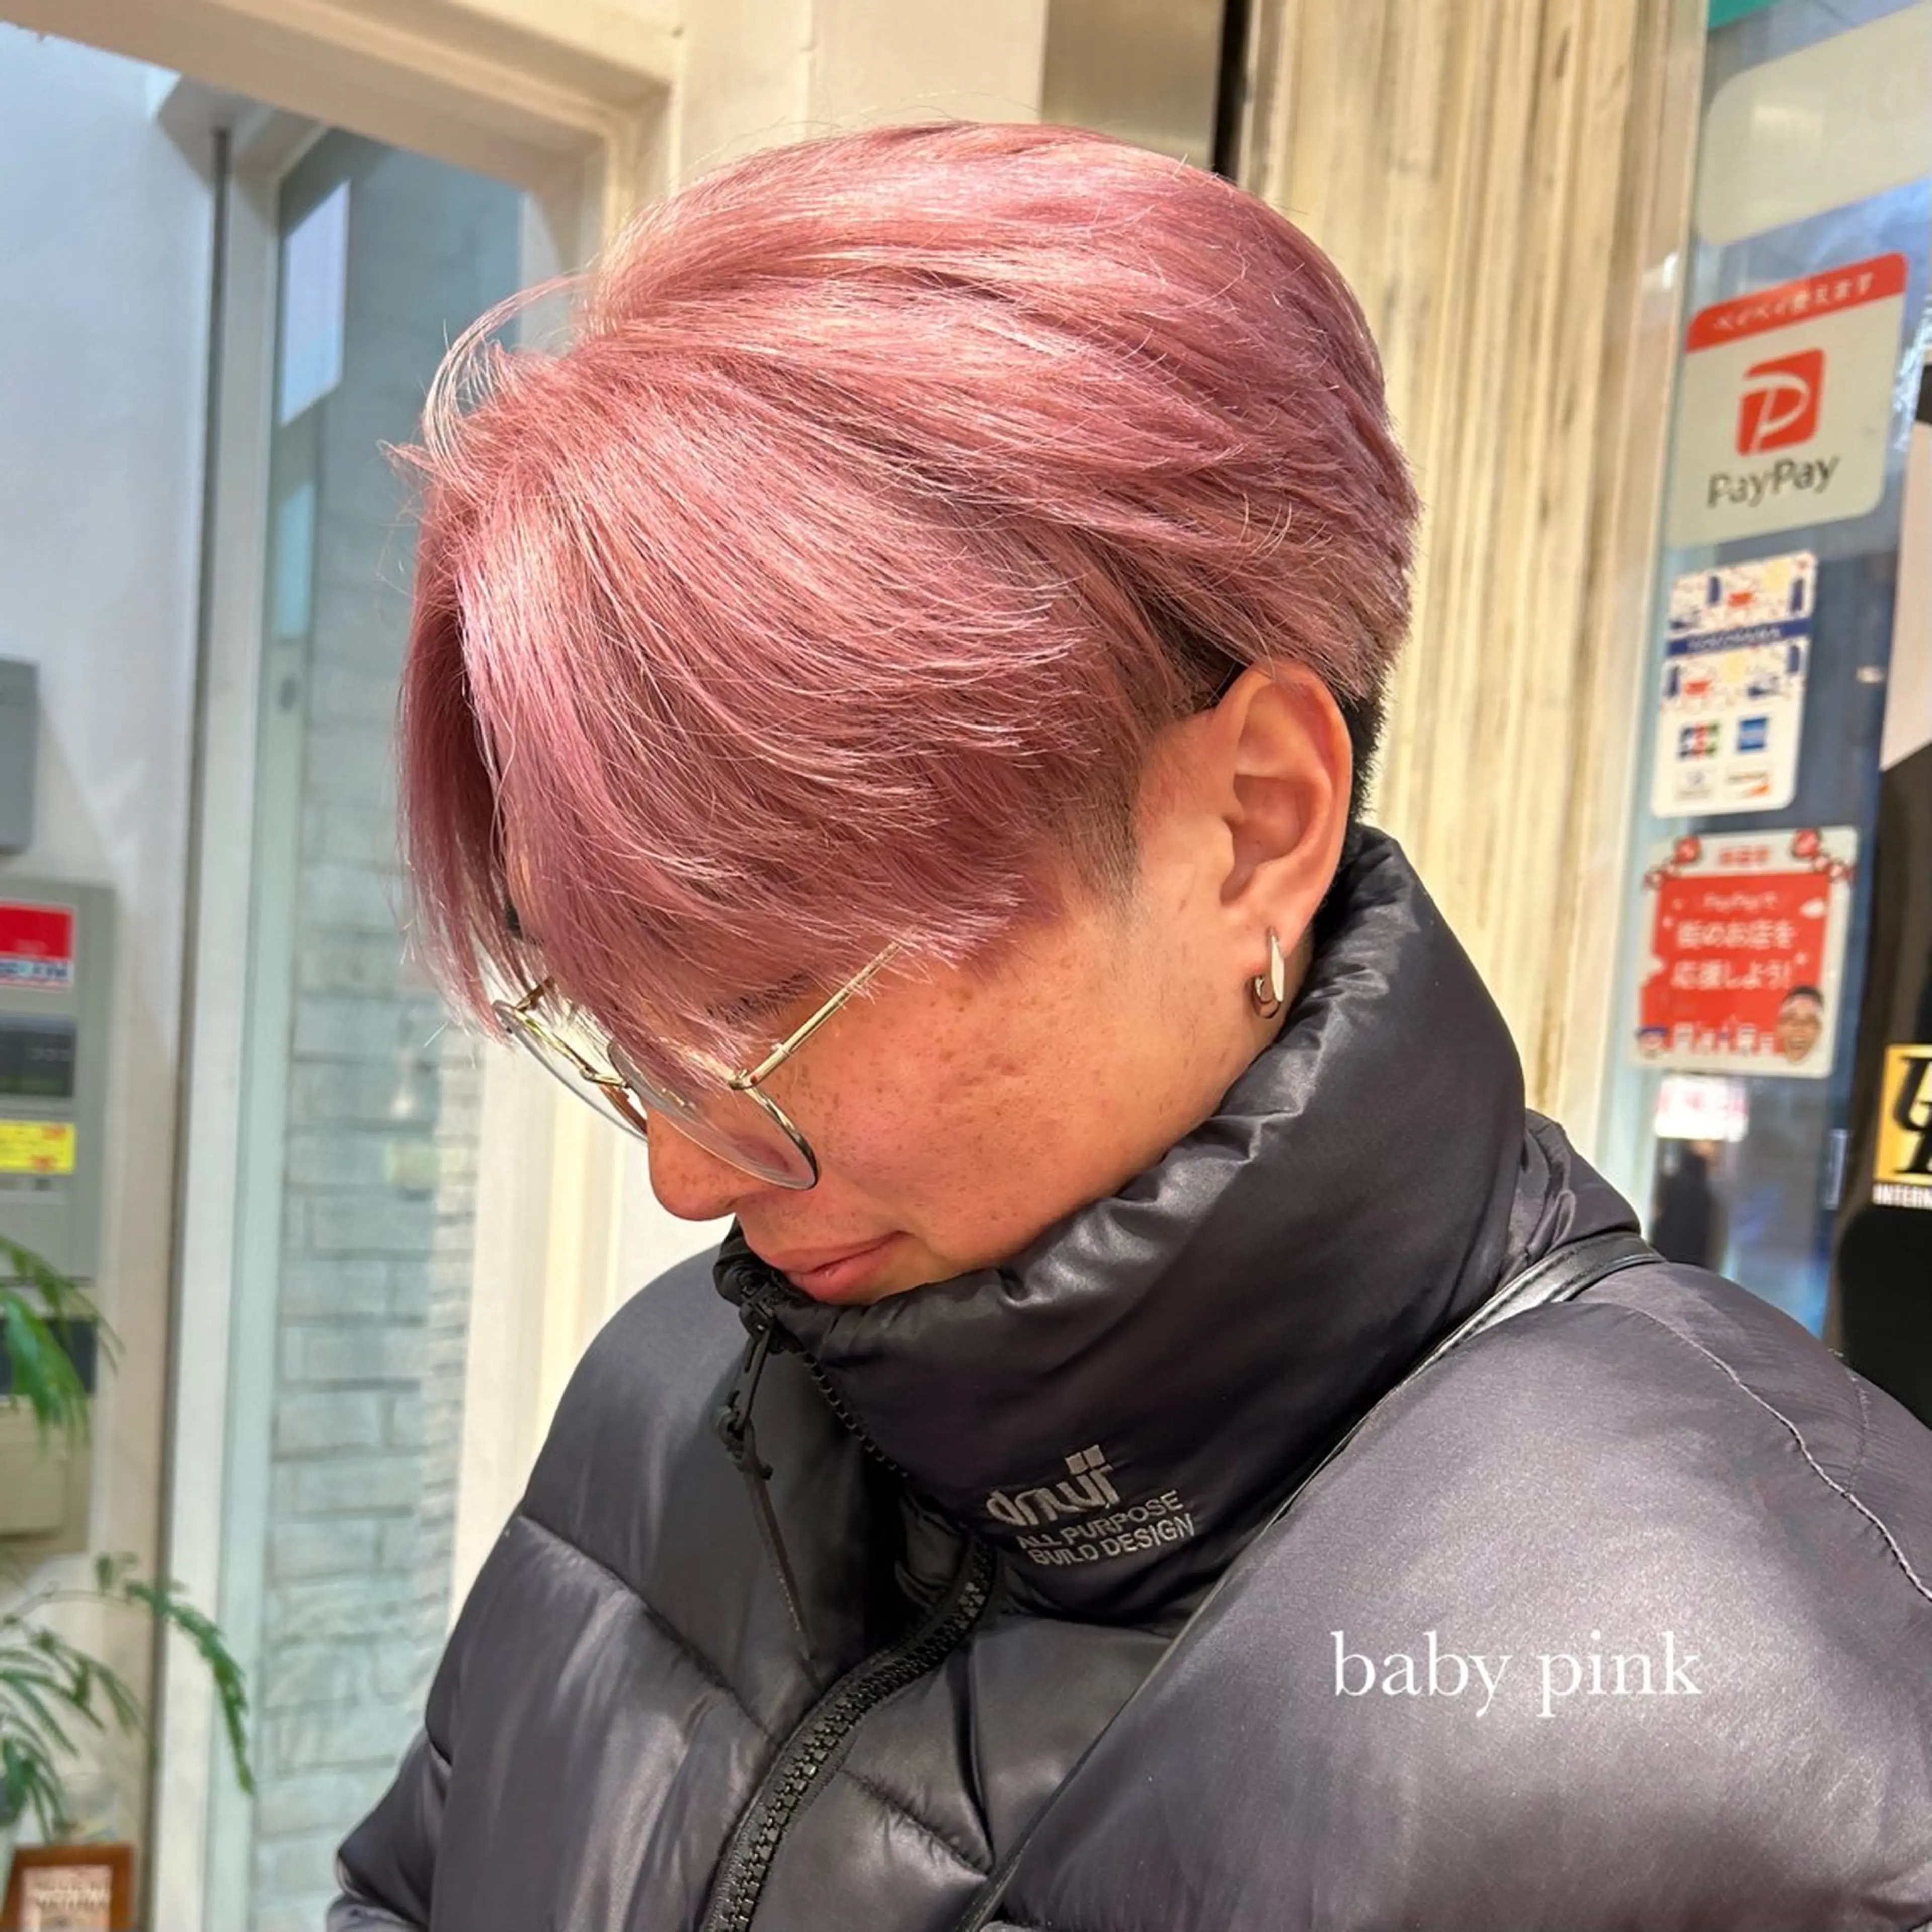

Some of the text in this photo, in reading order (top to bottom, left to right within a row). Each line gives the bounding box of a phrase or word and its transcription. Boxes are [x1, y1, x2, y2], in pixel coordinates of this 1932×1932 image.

[1707, 456, 1841, 509] PayPay
[1016, 1489, 1183, 1549] ALL PURPOSE
[1028, 1512, 1195, 1565] BUILD DESIGN
